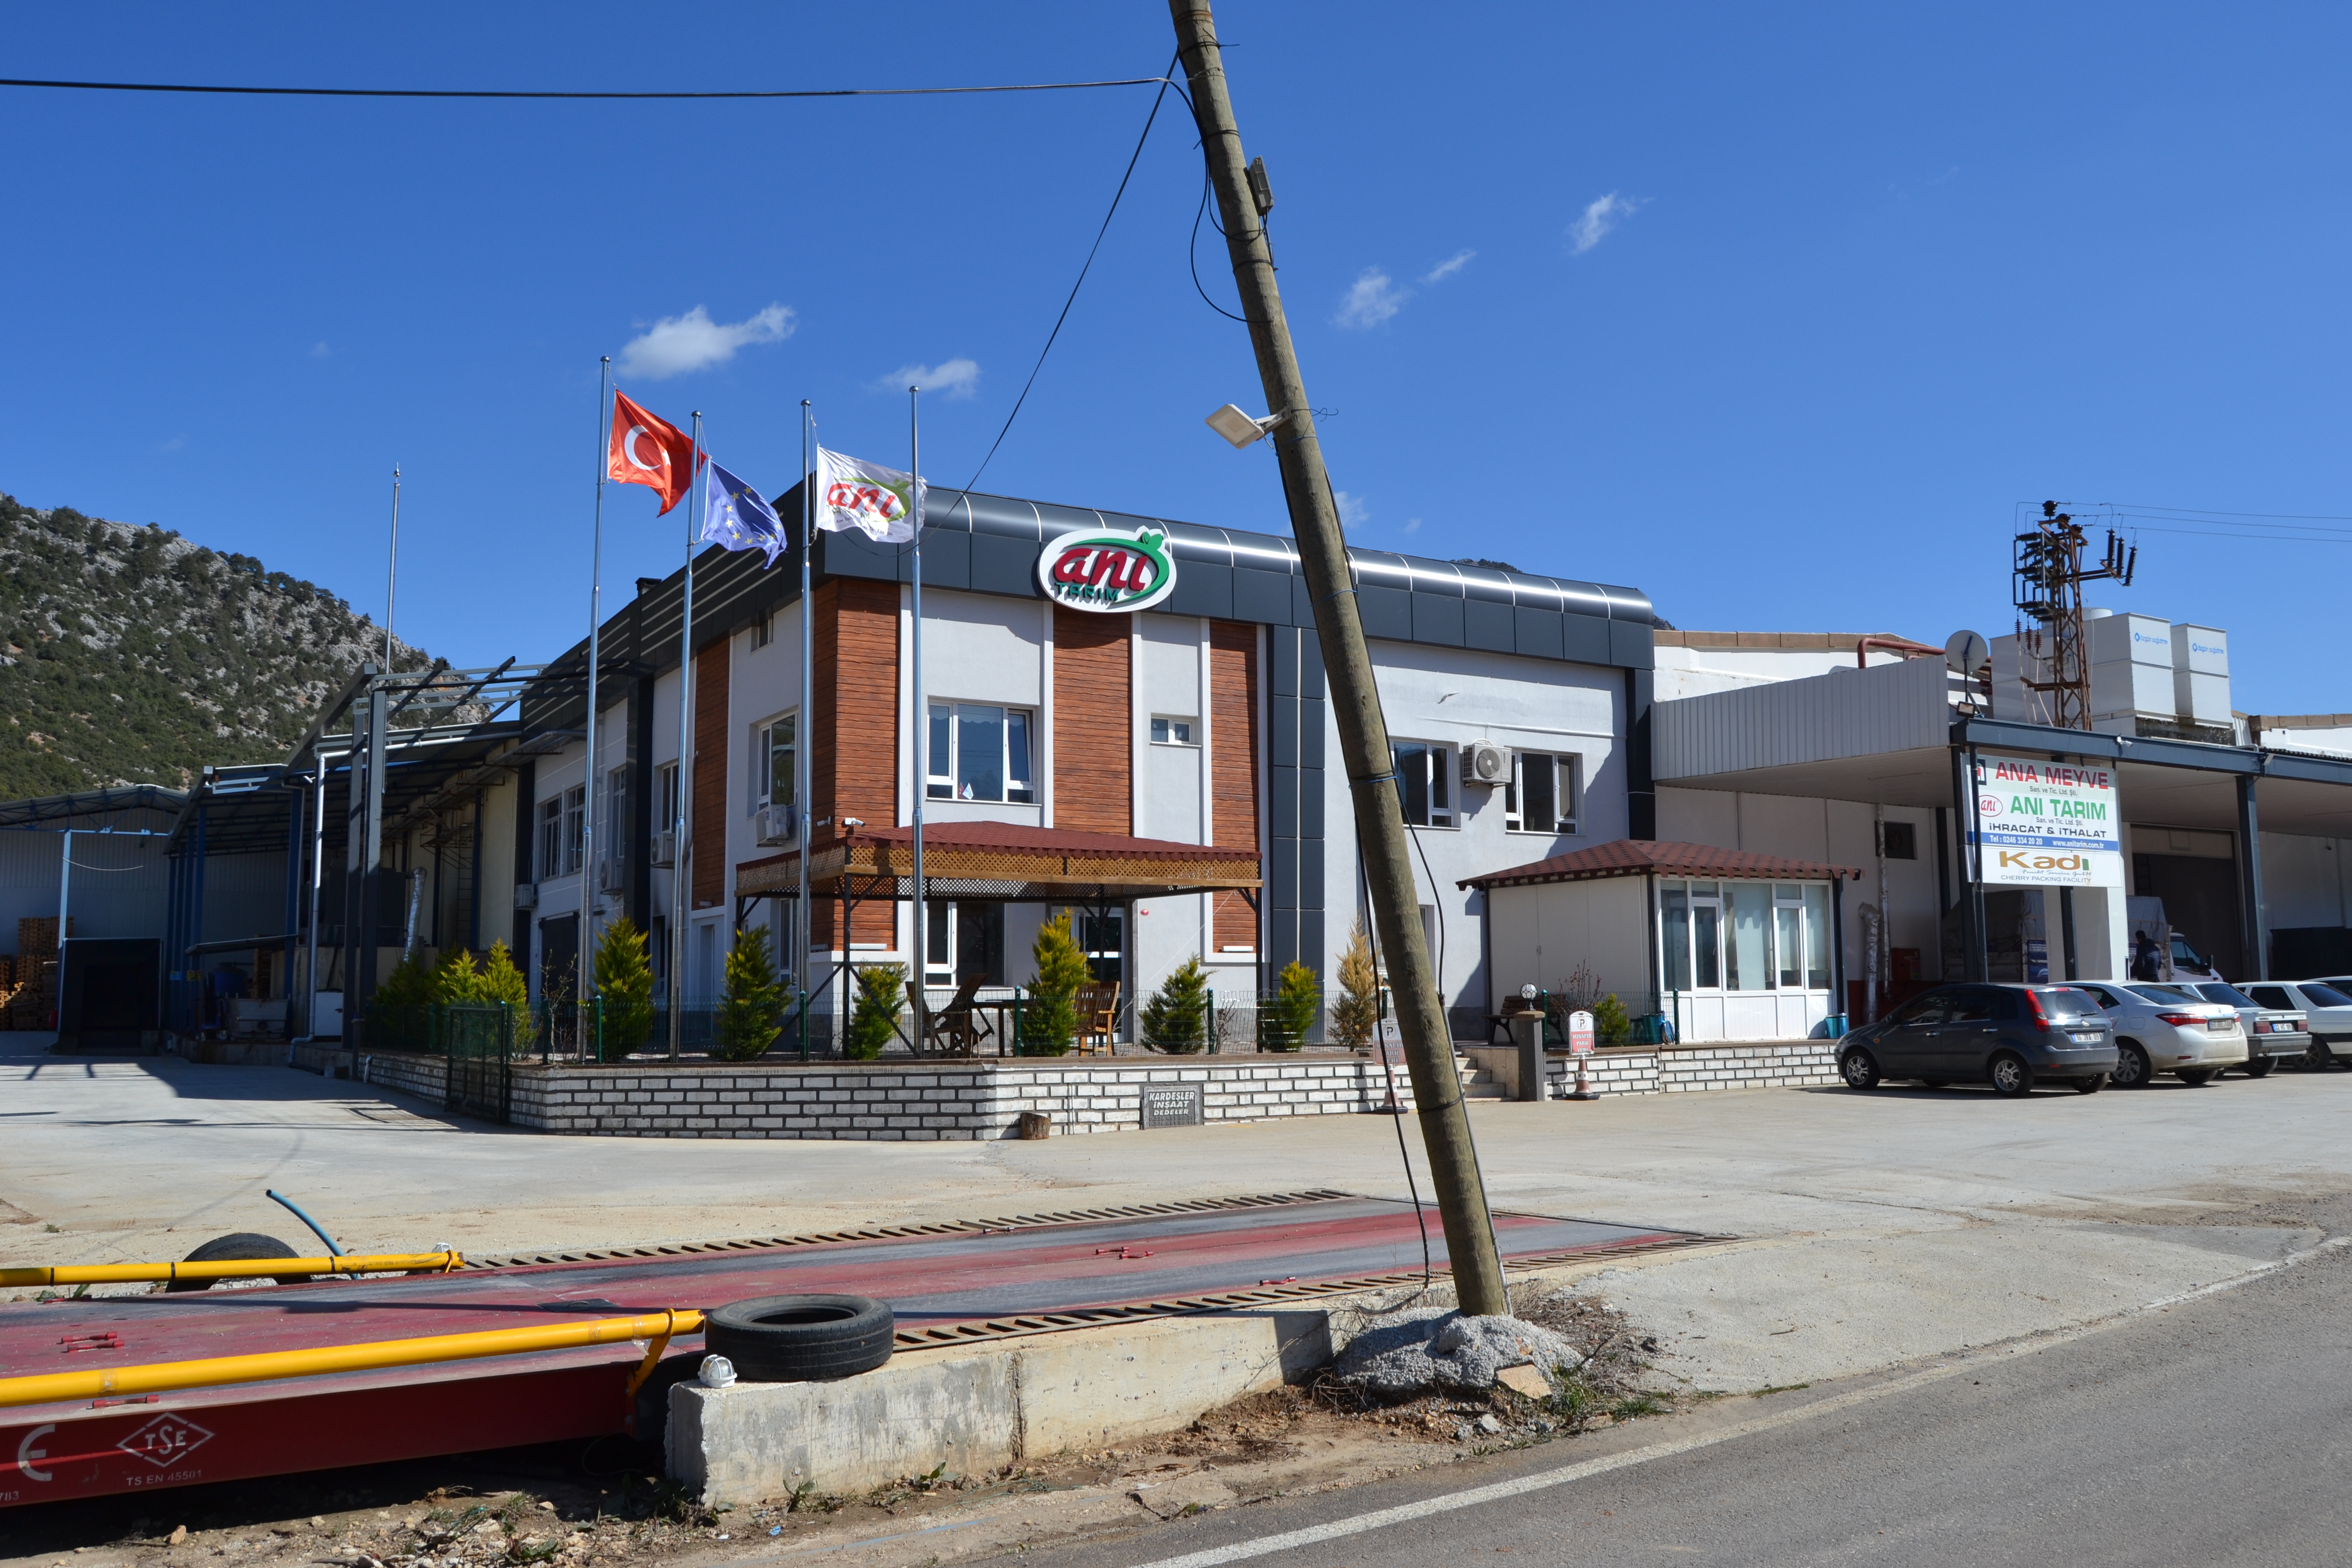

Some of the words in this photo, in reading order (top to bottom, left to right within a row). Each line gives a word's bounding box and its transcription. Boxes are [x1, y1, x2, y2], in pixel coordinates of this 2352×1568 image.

[1055, 582, 1118, 601] TARIM
[1995, 762, 2039, 783] ANA
[2045, 766, 2109, 790] MEYVE
[2010, 796, 2043, 816] ANI
[2050, 799, 2106, 820] TARIM
[2052, 840, 2104, 849] www.anitarim.com.tr
[1149, 1092, 1194, 1102] KARDEŞLER
[145, 1426, 186, 1455] TSE
[127, 1476, 142, 1486] TS
[146, 1474, 164, 1484] EN
[167, 1469, 202, 1482] 45501
